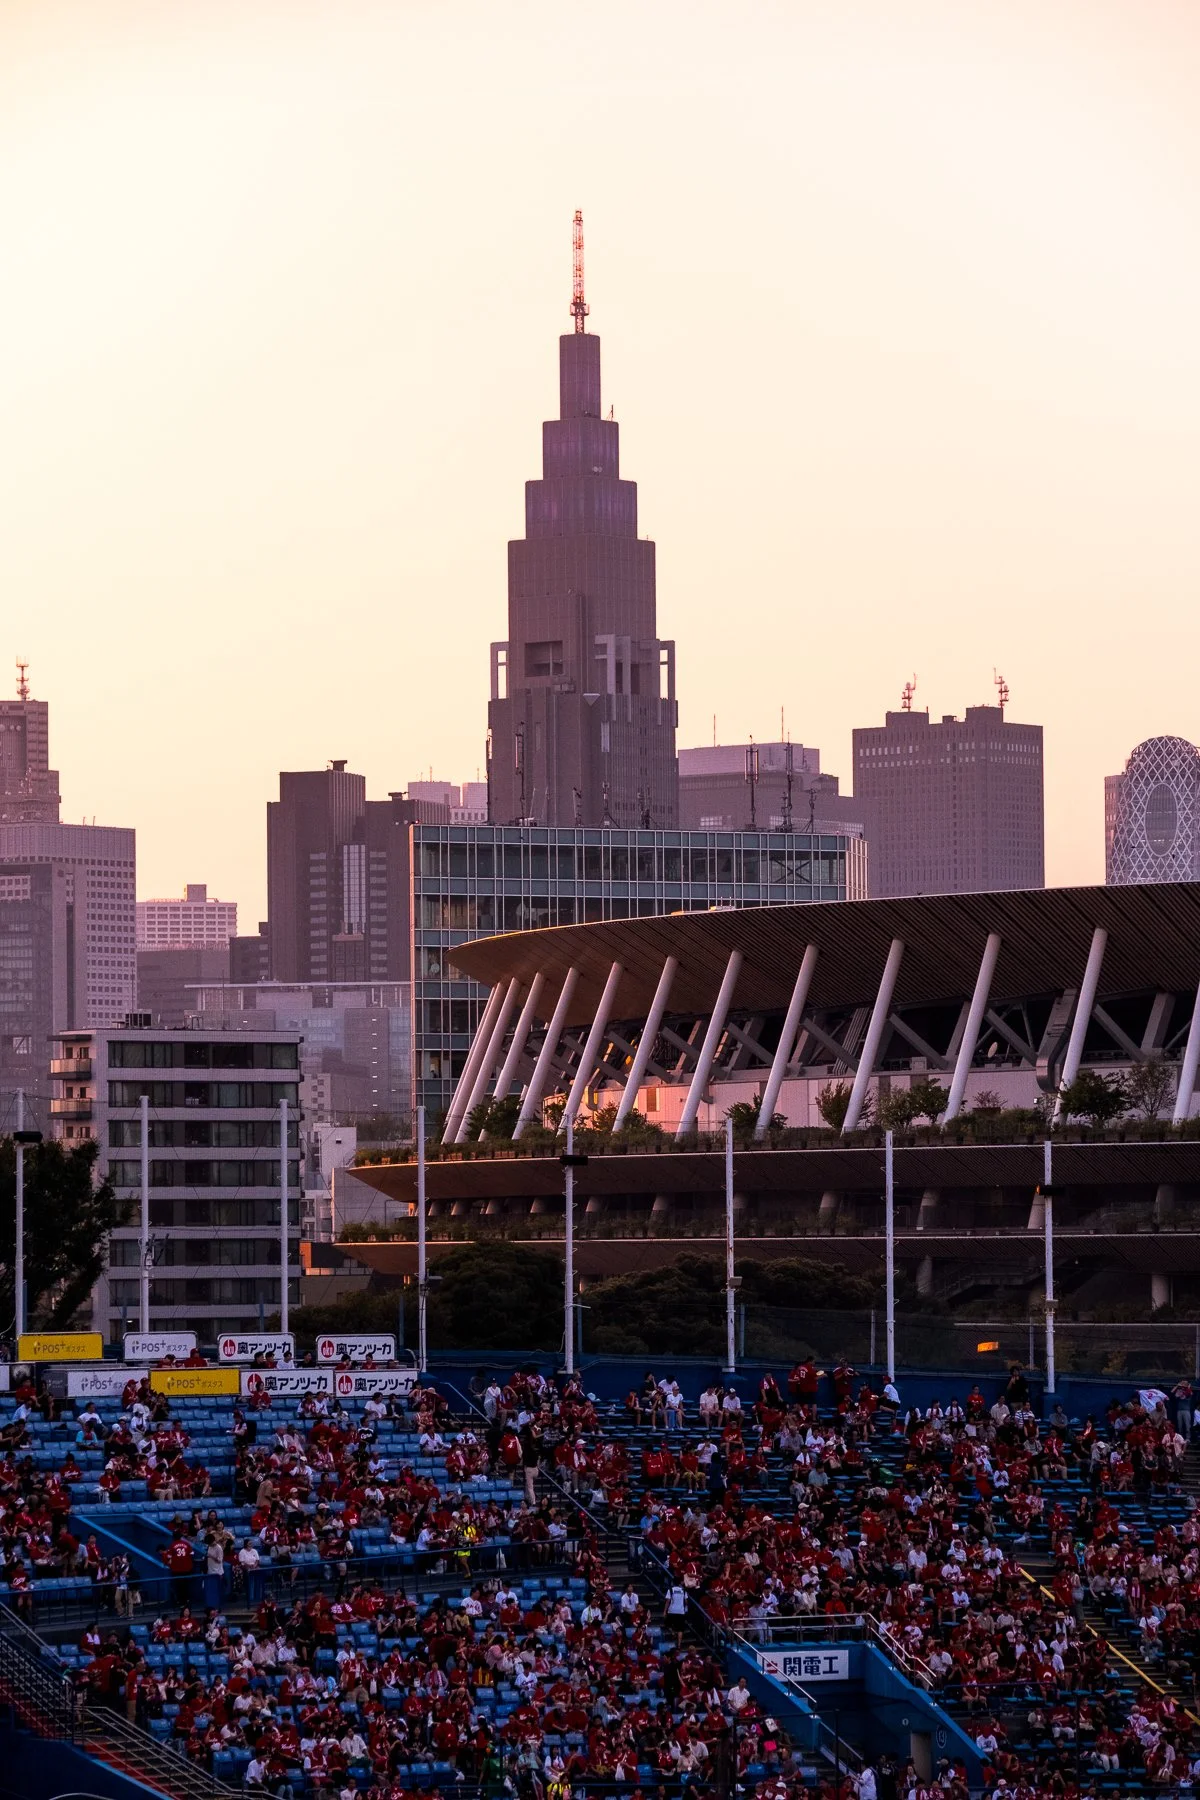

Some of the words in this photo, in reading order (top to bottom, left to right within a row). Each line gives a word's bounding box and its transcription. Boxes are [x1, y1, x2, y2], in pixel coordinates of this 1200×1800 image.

[42, 1341, 66, 1354] POS+
[142, 1340, 166, 1353] POS+
[177, 1377, 201, 1389] POS+
[783, 1656, 840, 1677] 関電工
